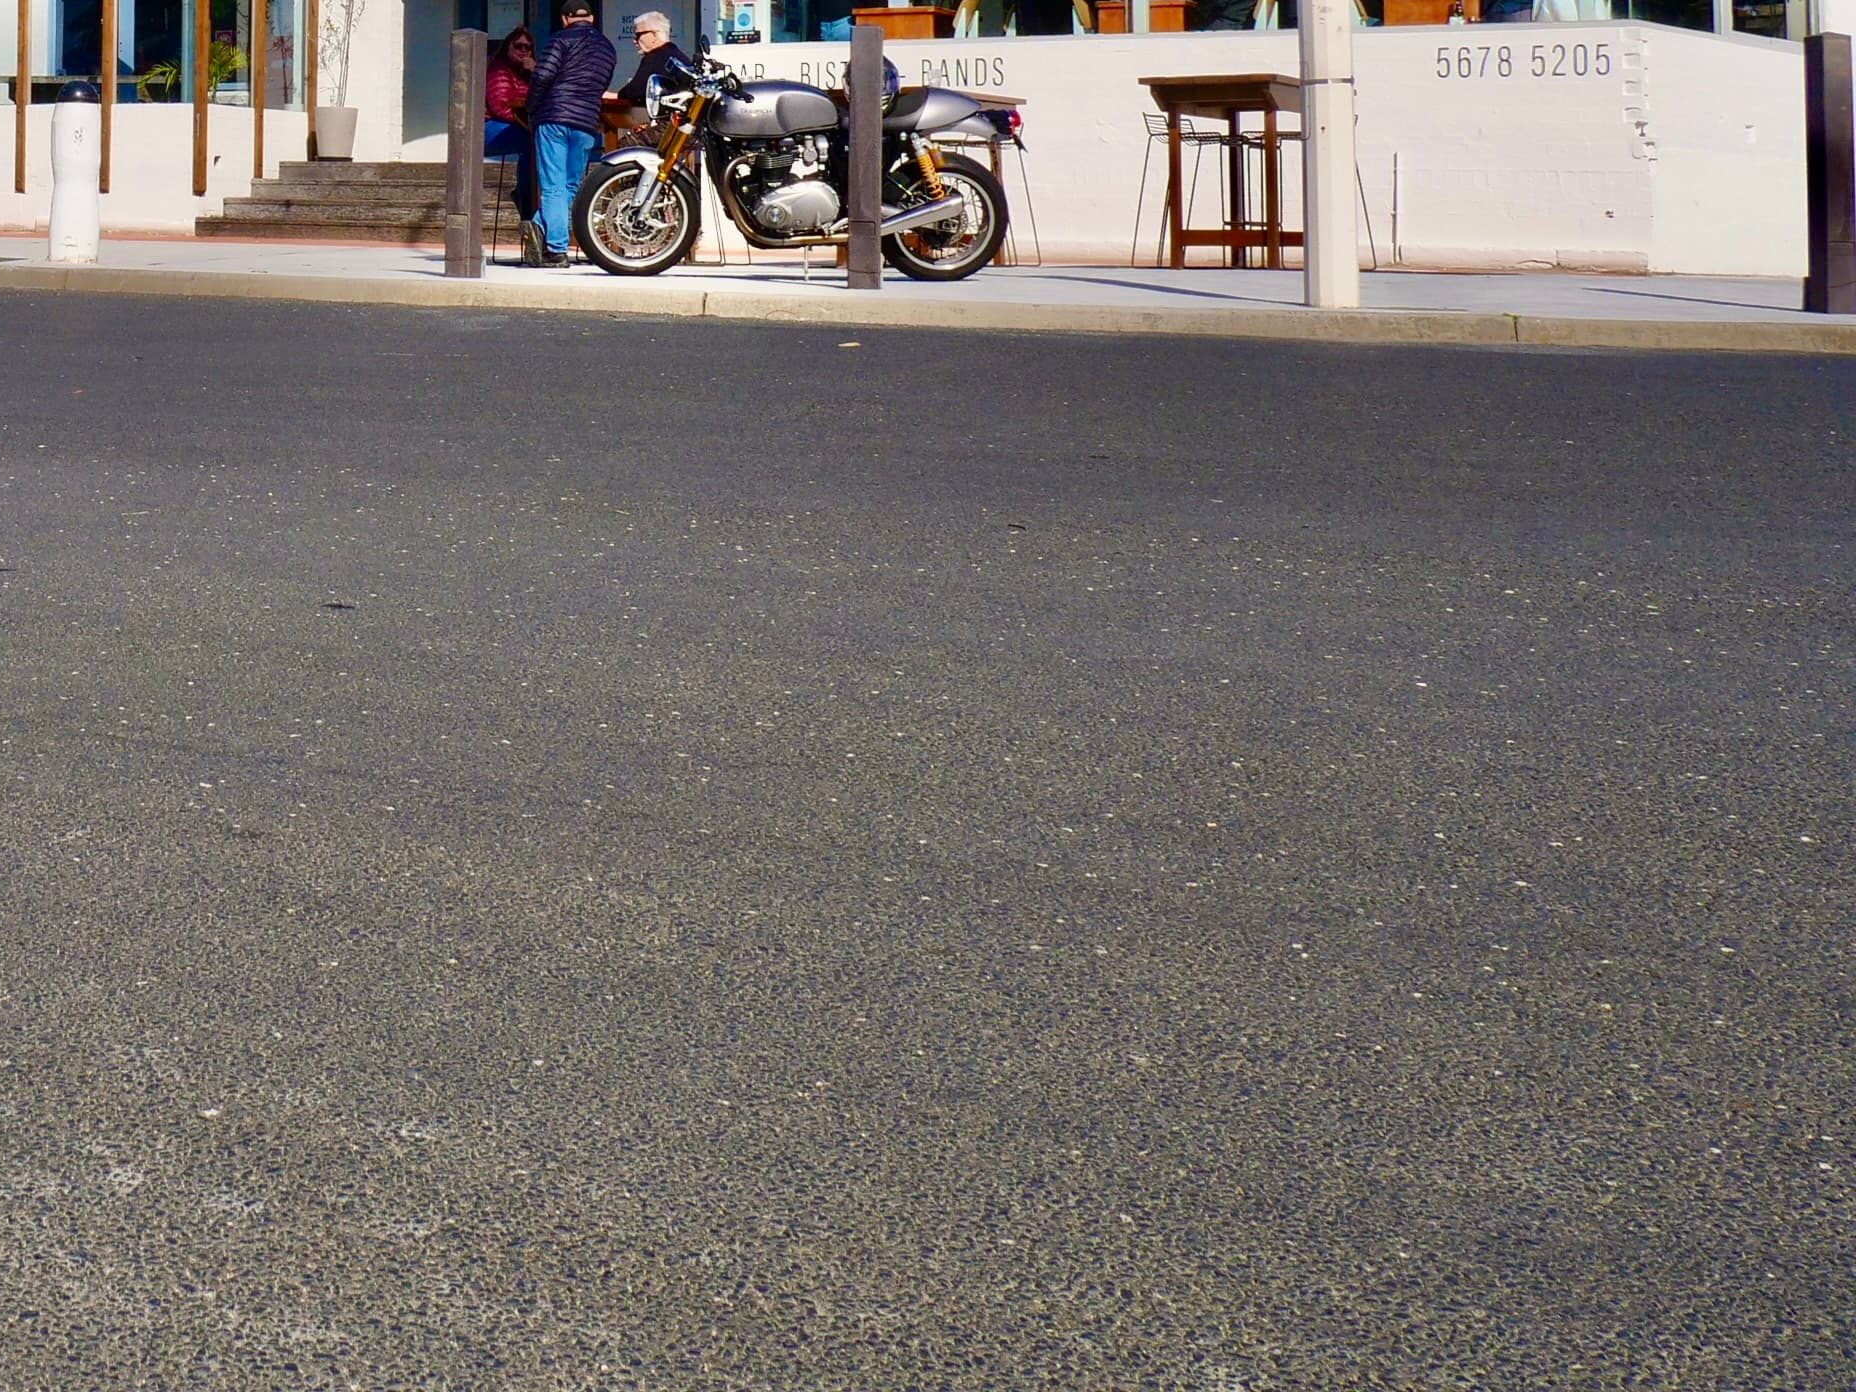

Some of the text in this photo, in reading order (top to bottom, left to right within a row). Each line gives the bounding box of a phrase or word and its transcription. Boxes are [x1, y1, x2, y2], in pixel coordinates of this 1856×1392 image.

[922, 56, 1005, 88] BANDS
[1436, 43, 1611, 79] 5678 5205
